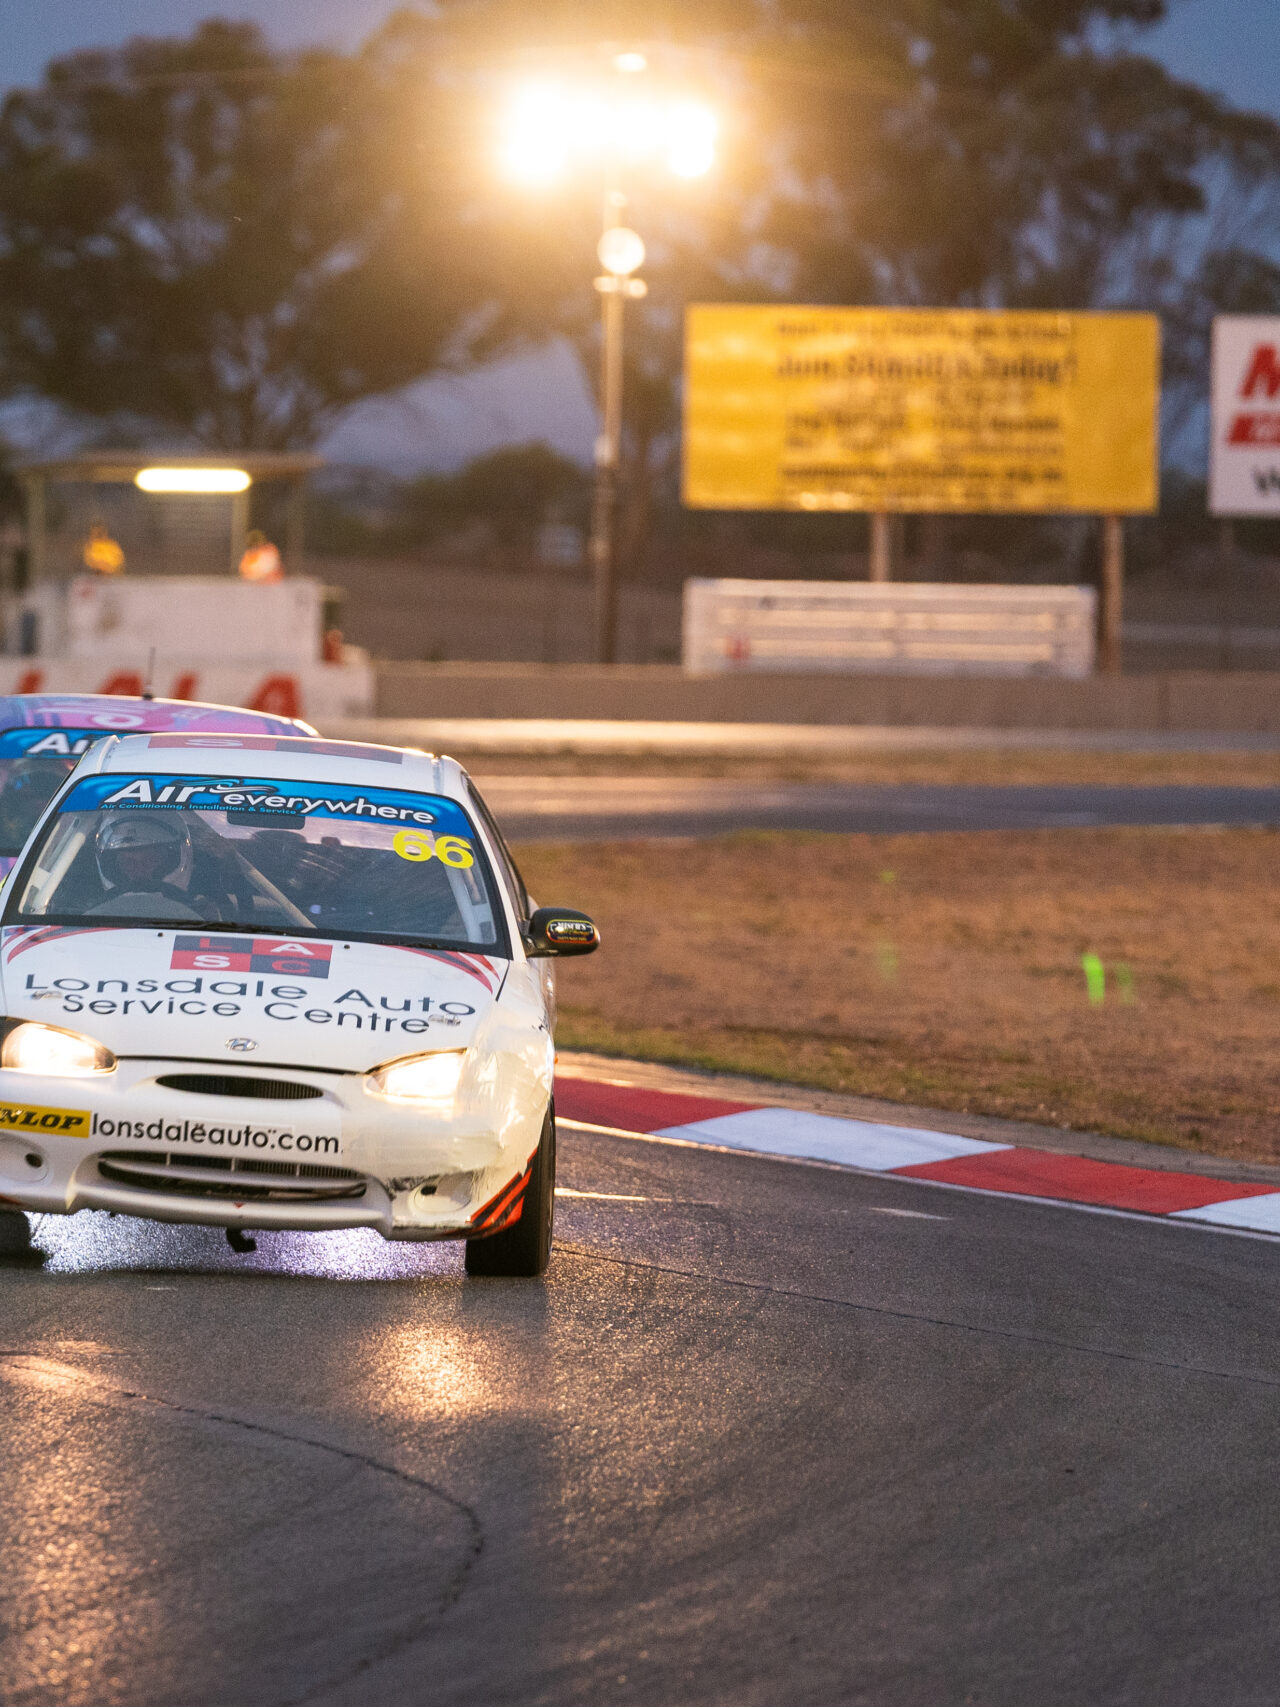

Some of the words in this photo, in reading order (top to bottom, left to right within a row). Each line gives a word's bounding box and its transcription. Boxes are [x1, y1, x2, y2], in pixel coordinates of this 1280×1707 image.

[26, 731, 90, 754] Ai
[103, 779, 205, 803] Air
[223, 791, 435, 824] everywhere
[189, 803, 245, 812] Installation
[260, 806, 297, 815] Service
[392, 829, 475, 869] 66
[25, 973, 308, 1000] Lonsdale
[333, 988, 477, 1016] Auto
[62, 993, 241, 1017] Service
[264, 1002, 429, 1034] Centre
